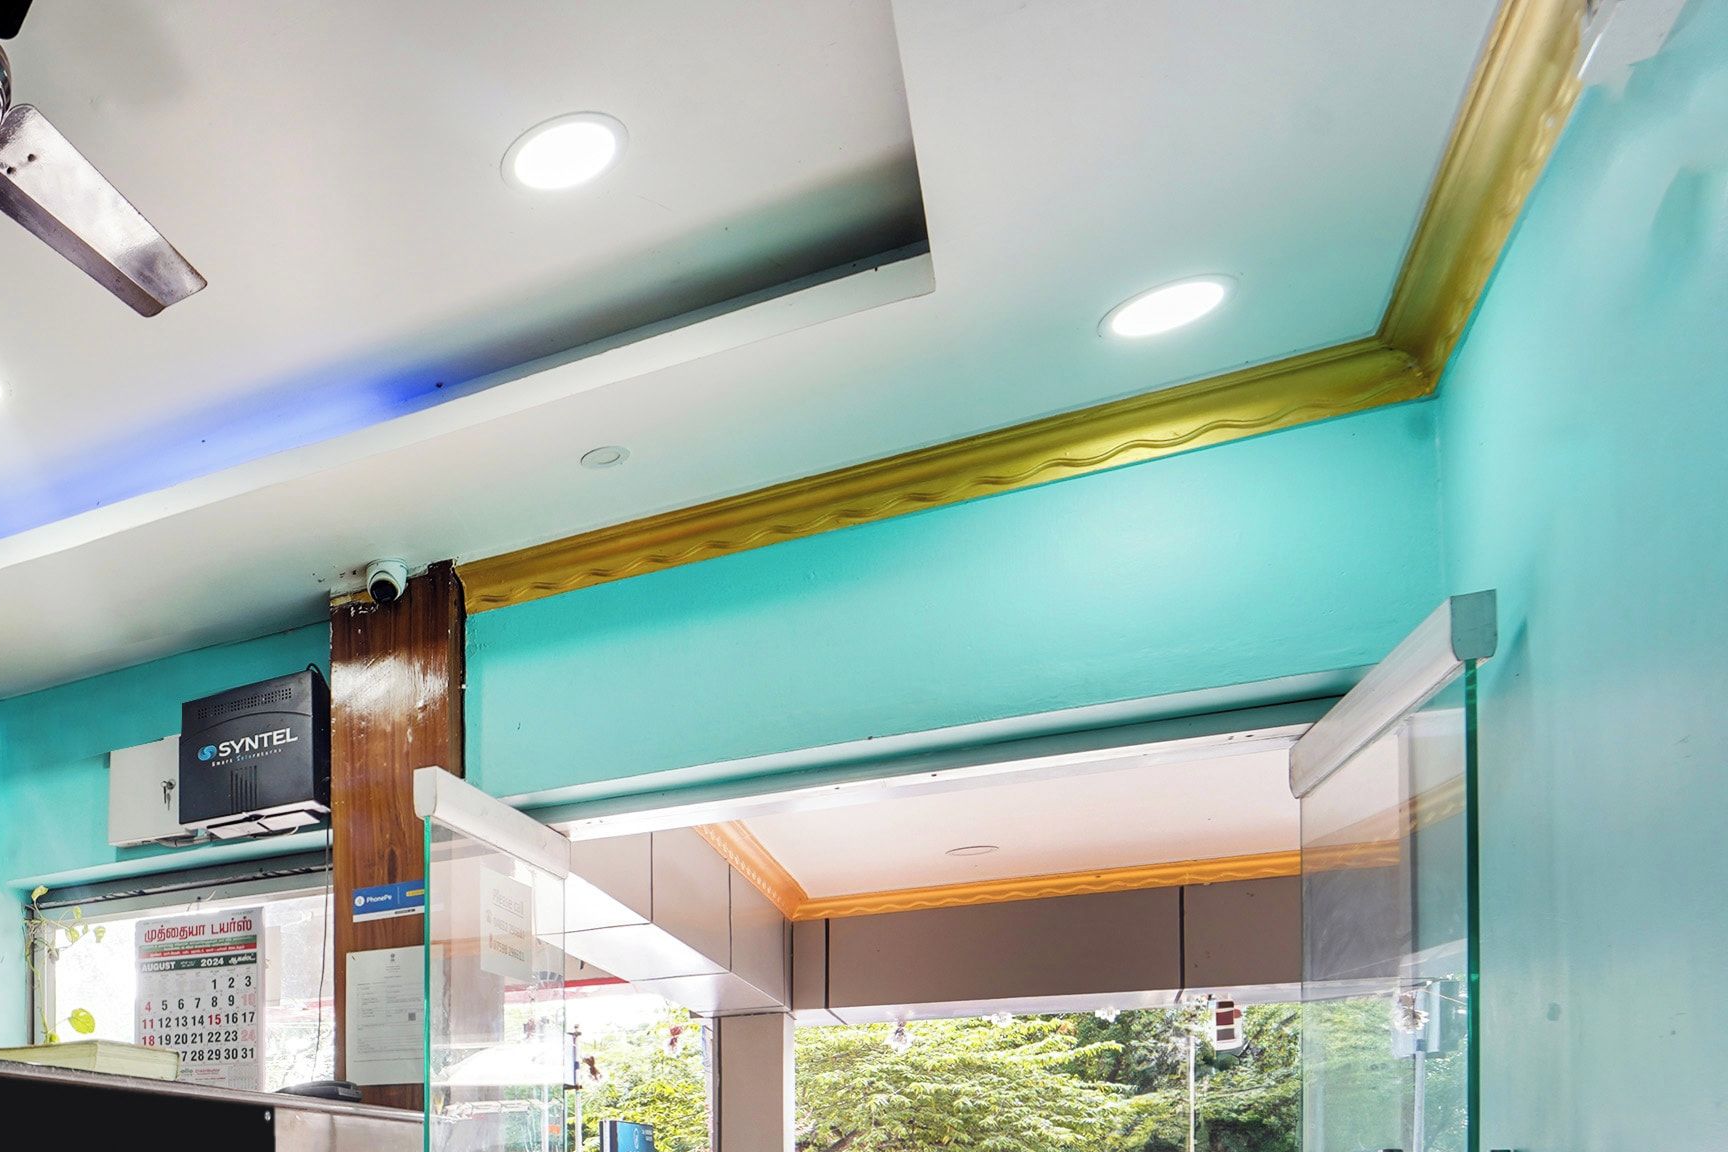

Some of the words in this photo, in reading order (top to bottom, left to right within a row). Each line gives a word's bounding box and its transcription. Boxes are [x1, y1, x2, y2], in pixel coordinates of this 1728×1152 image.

[218, 727, 299, 757] SYNTEL
[141, 961, 176, 973] AUGUST
[200, 957, 225, 968] 2024
[211, 978, 217, 990] 1
[228, 976, 235, 989] 2
[244, 975, 252, 988] 3
[144, 1001, 153, 1013] 4
[161, 999, 168, 1011] 5
[177, 998, 185, 1010] 6
[194, 997, 201, 1009] 7
[211, 995, 218, 1008] 8
[227, 994, 235, 1007] 9
[142, 1018, 154, 1030] 11
[158, 1017, 172, 1029] 12
[174, 1015, 188, 1027] 13
[191, 1014, 204, 1026] 14
[207, 1013, 222, 1026] 15
[224, 1012, 238, 1024] 16
[241, 1011, 255, 1023] 17
[142, 1035, 155, 1047] 18
[158, 1034, 172, 1046] 19
[174, 1033, 188, 1045] 20
[190, 1032, 203, 1044] 21
[207, 1031, 221, 1043] 22
[224, 1030, 238, 1042] 23
[190, 1049, 205, 1062] 28
[207, 1048, 221, 1061] 29
[224, 1047, 238, 1060] 30
[241, 1047, 255, 1060] 31
